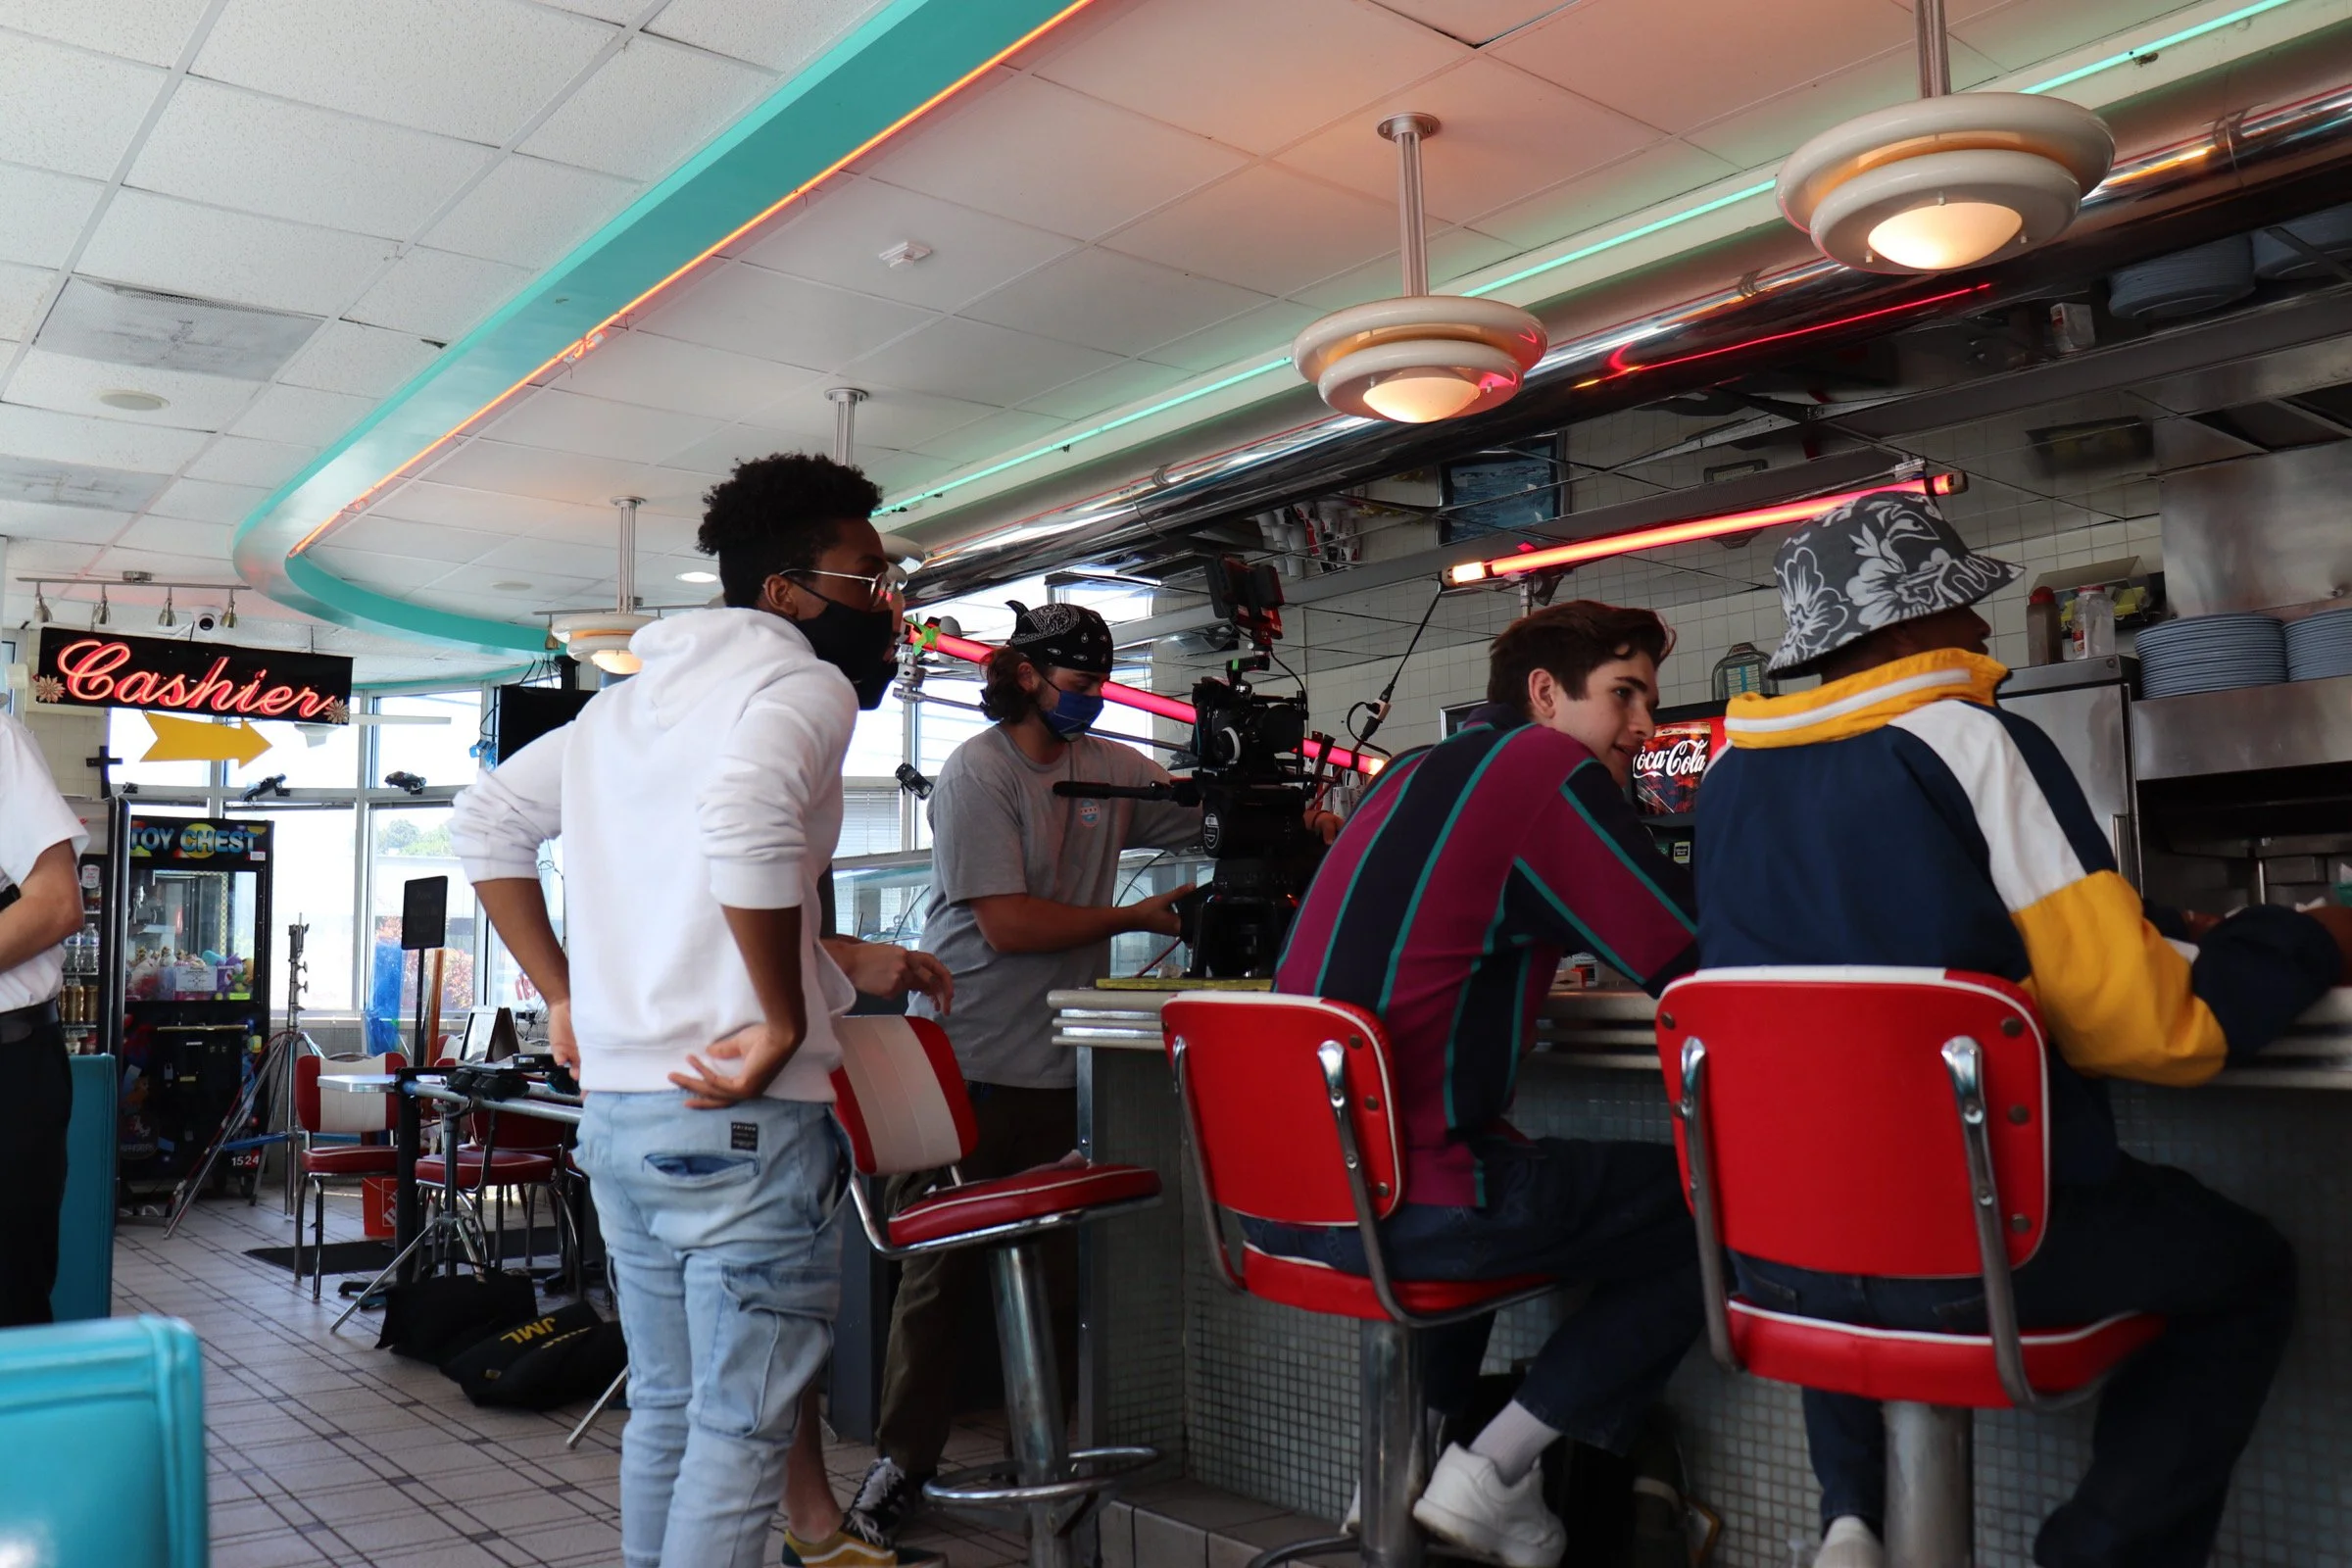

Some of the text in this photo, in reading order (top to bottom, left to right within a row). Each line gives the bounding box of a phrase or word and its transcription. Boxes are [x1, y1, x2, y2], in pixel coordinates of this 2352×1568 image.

[57, 640, 336, 718] Cashier
[130, 826, 258, 854] TOY CHEST
[231, 1154, 261, 1167] 1524
[499, 1317, 557, 1345] JML
